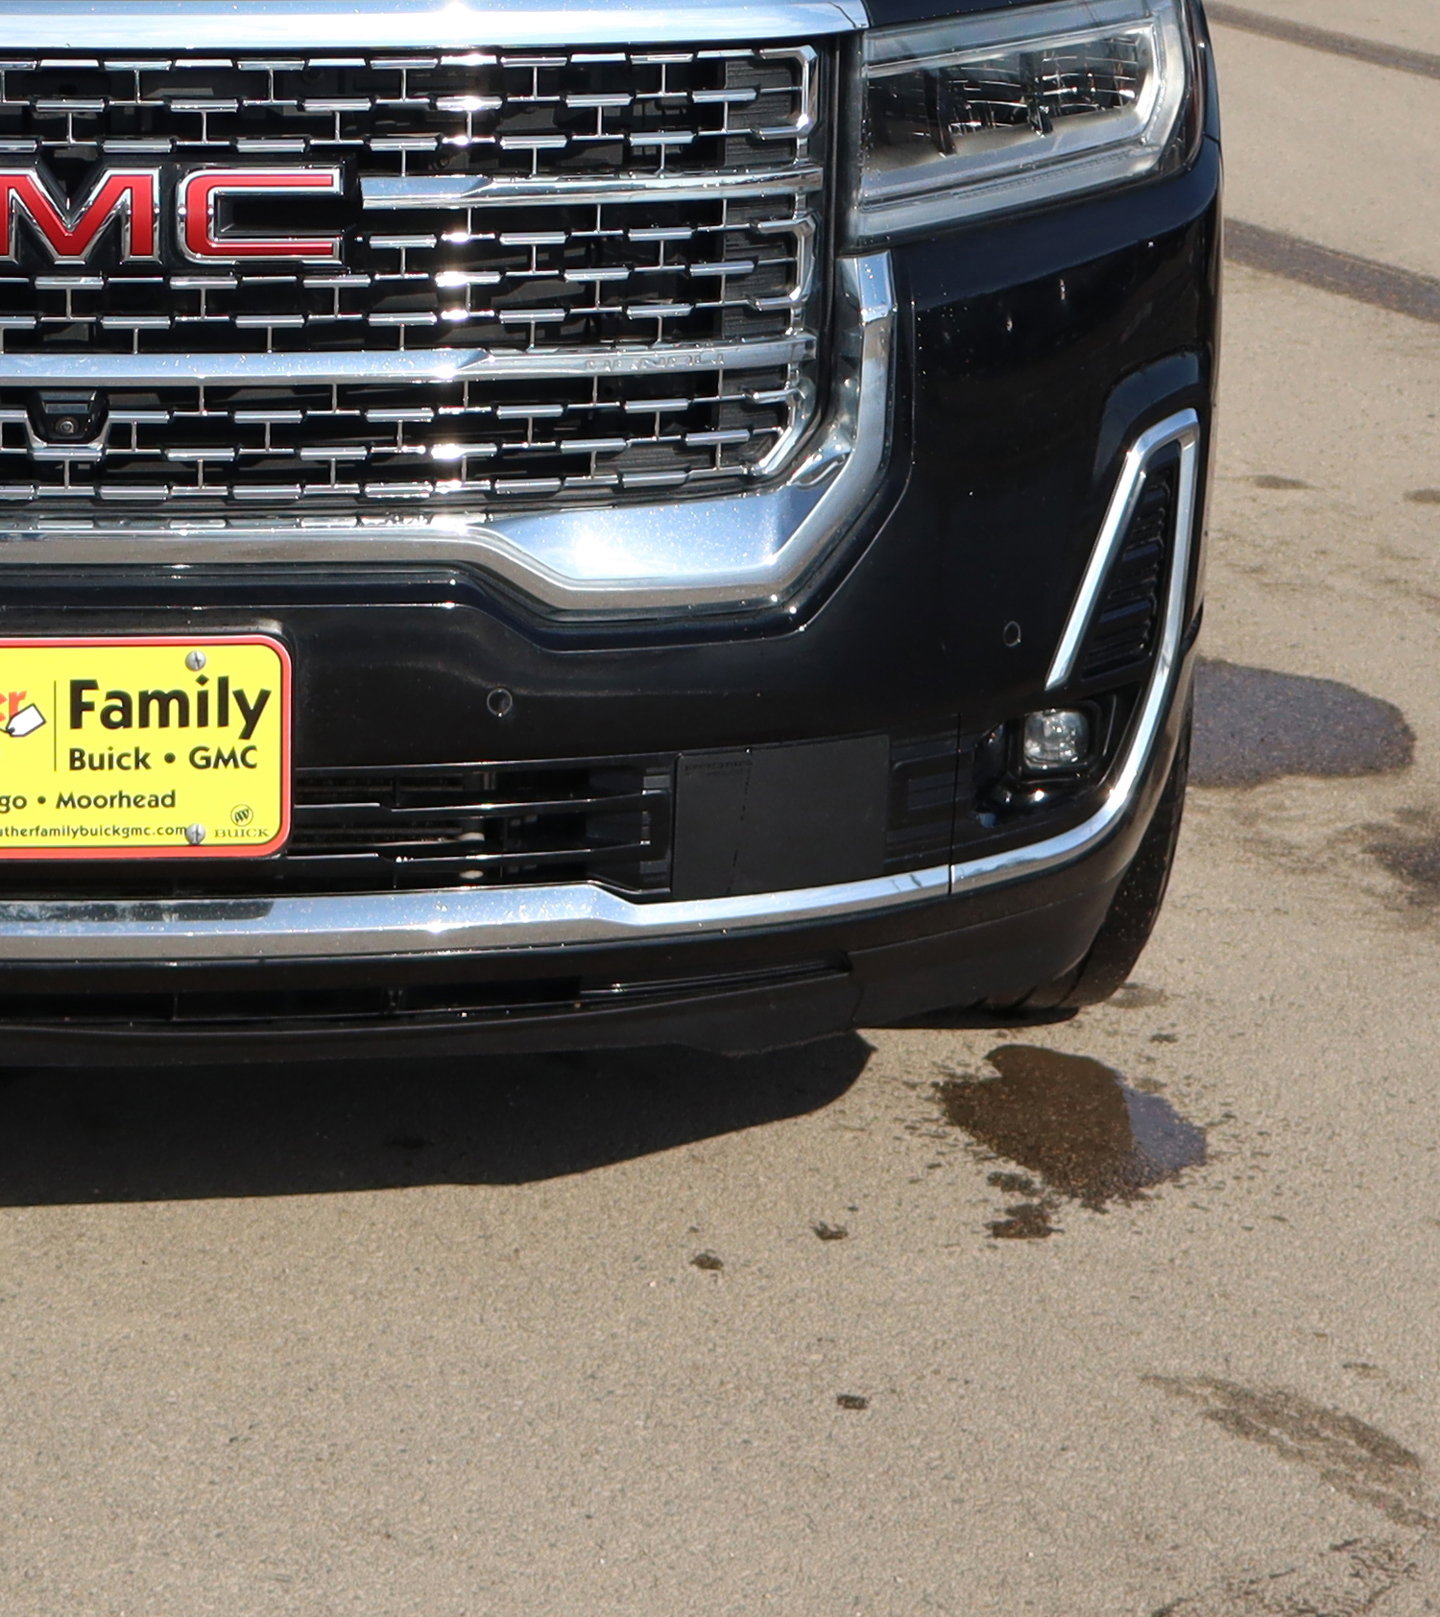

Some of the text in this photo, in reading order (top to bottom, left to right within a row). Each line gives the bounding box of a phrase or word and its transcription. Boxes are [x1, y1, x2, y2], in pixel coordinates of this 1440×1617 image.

[69, 673, 272, 740] Family
[69, 745, 258, 771] Buick GMC
[55, 789, 176, 810] Moorhead
[214, 828, 270, 838] BUICK
